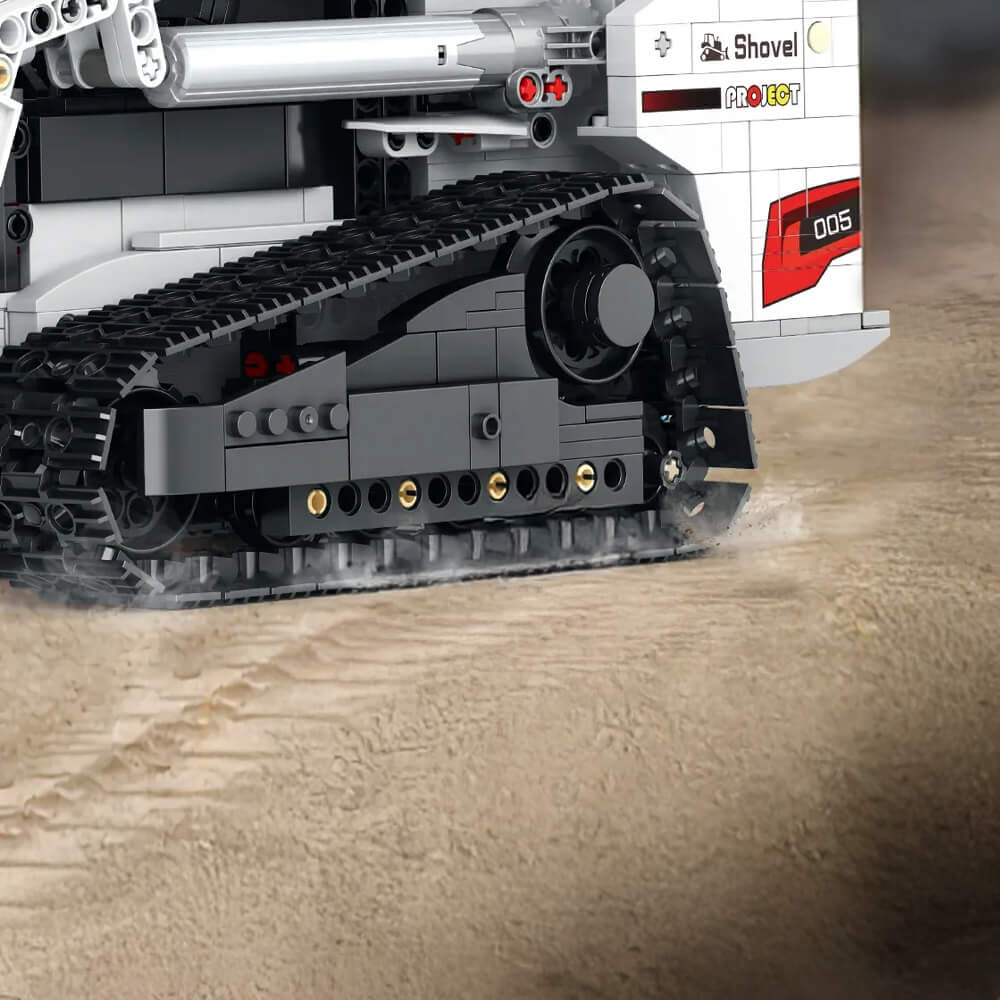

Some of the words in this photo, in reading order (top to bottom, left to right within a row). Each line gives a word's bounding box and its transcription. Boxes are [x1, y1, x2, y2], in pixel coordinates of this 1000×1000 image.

[734, 31, 798, 60] Shovel
[725, 83, 801, 109] PROJECT
[813, 208, 852, 240] 005
